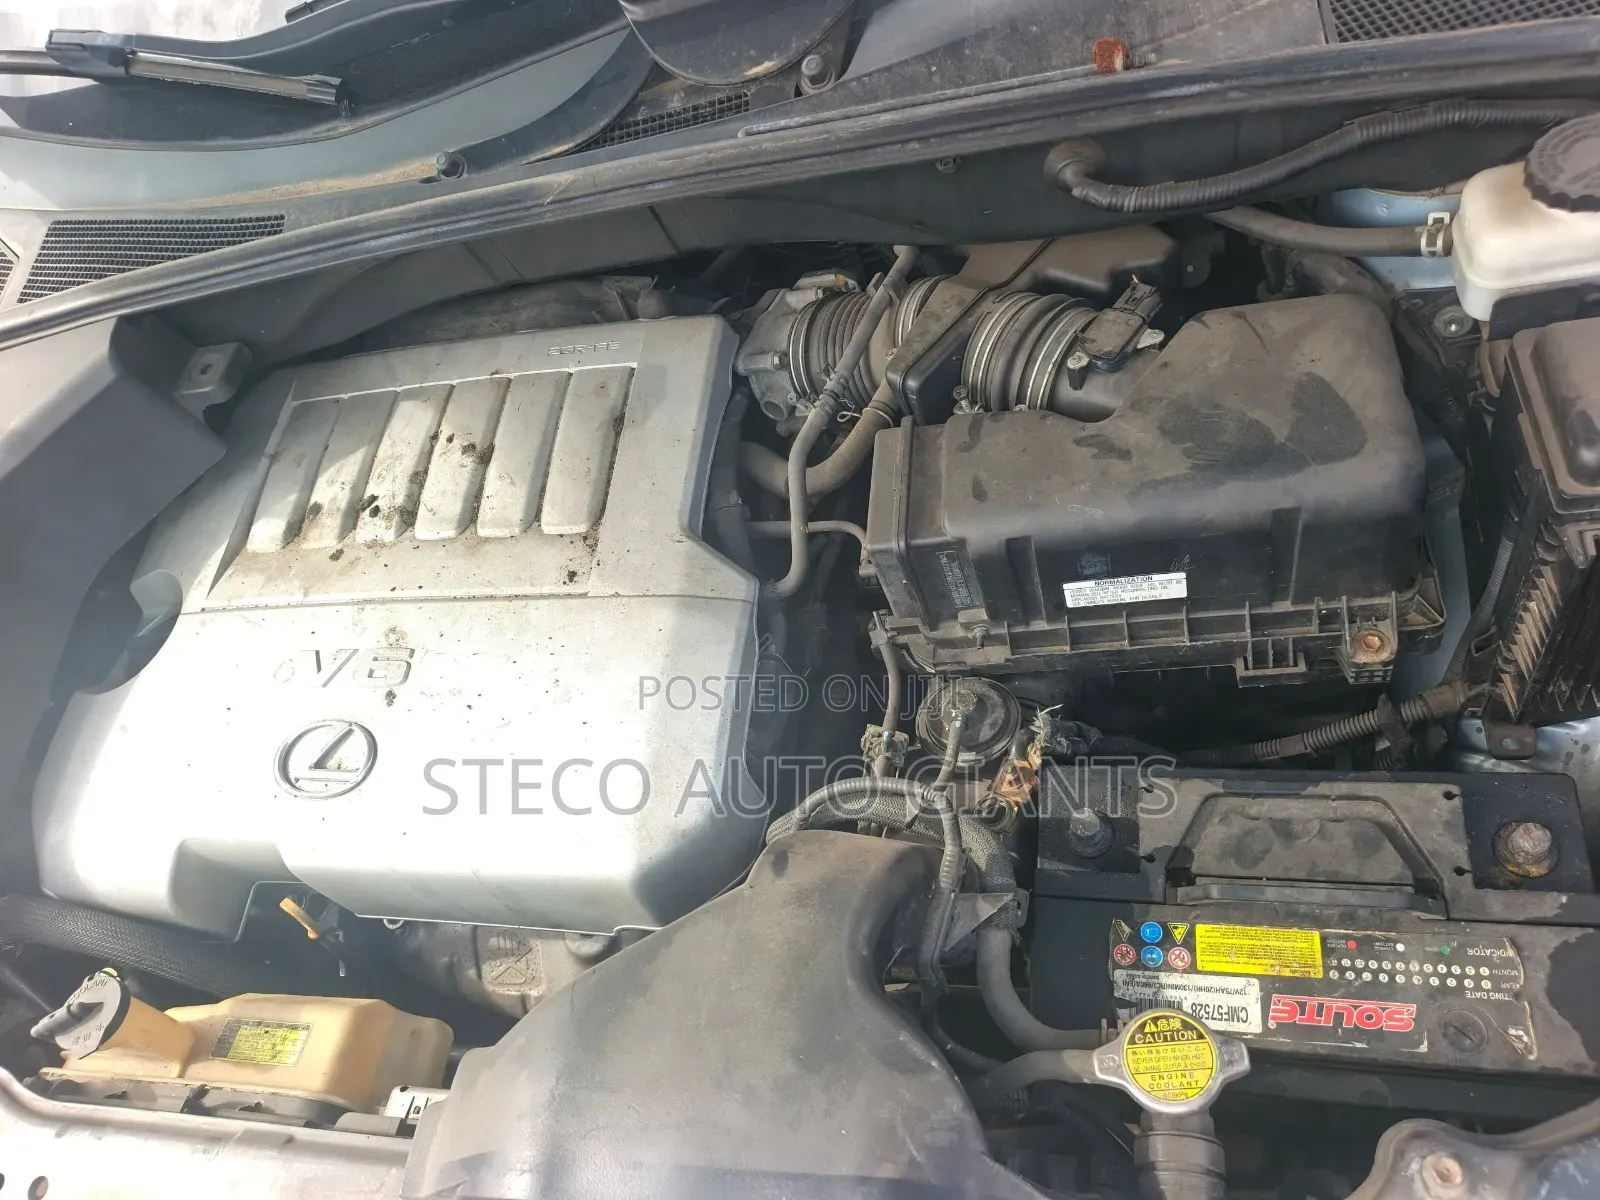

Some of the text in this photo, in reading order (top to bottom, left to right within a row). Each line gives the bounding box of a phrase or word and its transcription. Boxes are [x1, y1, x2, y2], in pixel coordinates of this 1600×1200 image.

[1094, 576, 1153, 586] NORMALIZATION
[301, 647, 416, 688] V6
[1467, 948, 1513, 957] NDICATOR
[1465, 990, 1488, 999] DATE
[1190, 1002, 1249, 1022] CMF57528
[1269, 995, 1416, 1032] SOLITE
[1157, 1018, 1182, 1031] 危険
[1134, 1030, 1198, 1044] CAUTION
[1132, 1056, 1153, 1064] NEVER
[1150, 1072, 1195, 1082] ENGINE
[1148, 1080, 1200, 1090] COOLANT
